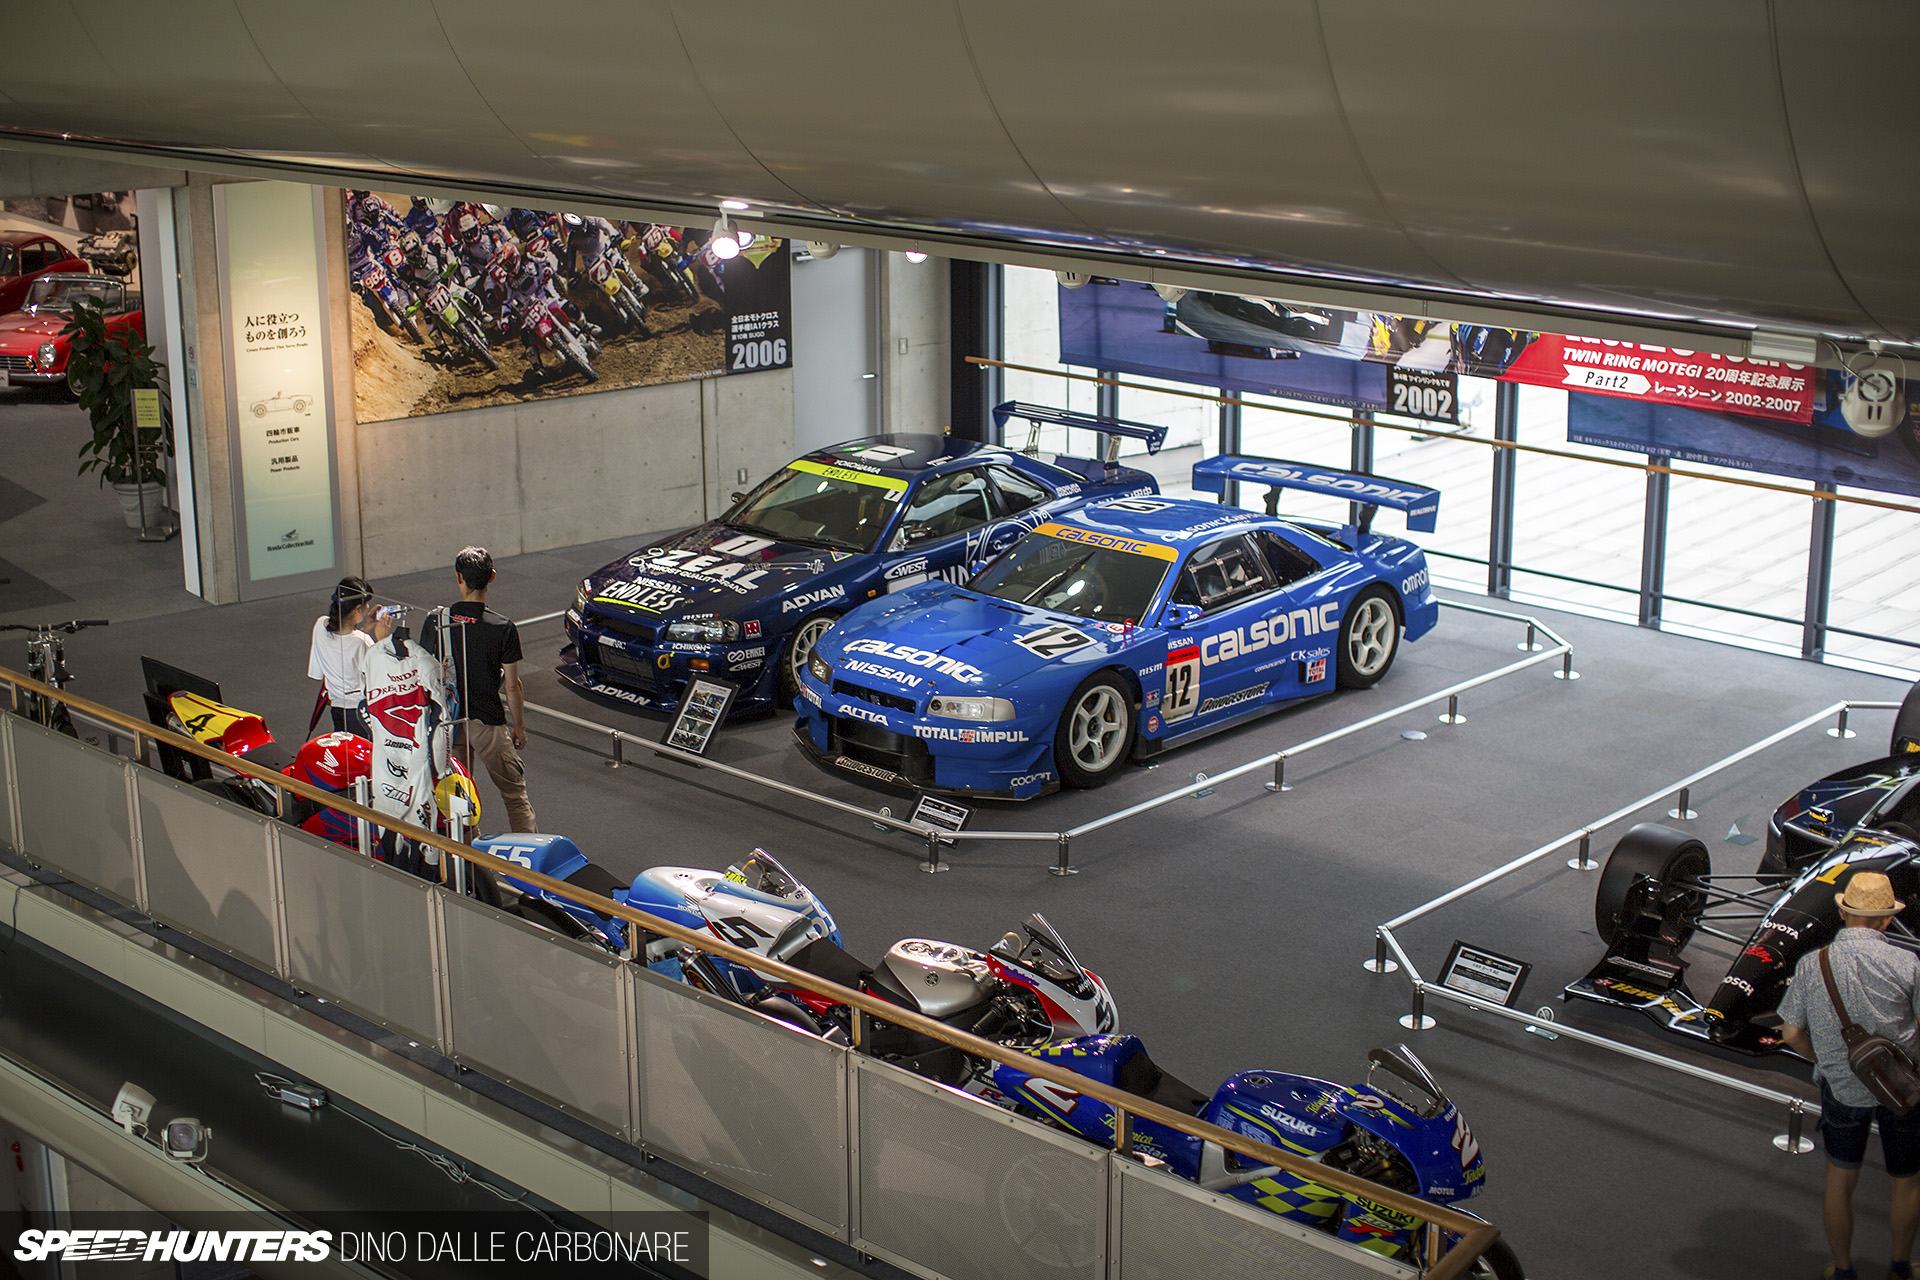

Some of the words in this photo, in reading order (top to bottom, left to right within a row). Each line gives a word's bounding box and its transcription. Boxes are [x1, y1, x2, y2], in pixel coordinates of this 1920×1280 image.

[245, 313, 300, 328] 人に役立つ
[731, 311, 779, 324] 全日本モトクロス
[246, 326, 306, 343] ものを創ろう
[732, 338, 787, 369] 2006
[1563, 347, 1602, 365] TWIN
[1602, 352, 1641, 370] RING
[1642, 358, 1703, 378] MOTEGI
[1585, 371, 1629, 389] Part2
[1393, 382, 1453, 419] 2002
[1654, 380, 1722, 402] レースシーン
[1726, 391, 1801, 413] 2002-2007
[822, 467, 860, 480] ENDLESS
[834, 459, 881, 475] YOKOHAMA
[652, 549, 768, 591] ZEAL
[600, 580, 686, 611] ENDLESS
[633, 576, 681, 595] NISSAN
[782, 584, 845, 613] ADVAN
[672, 643, 707, 652] ICHIKOH
[745, 646, 766, 659] ENKEI
[1020, 626, 1091, 657] 12
[1290, 650, 1306, 661] CK
[1306, 646, 1331, 659] sales
[844, 659, 923, 688] NISSAN
[1308, 667, 1326, 677] TOTAL
[591, 684, 651, 706] ADVAN
[1169, 664, 1192, 711] 12
[1197, 681, 1270, 711] BRIDGESTONE
[806, 688, 822, 710] TOTAL
[184, 713, 217, 735] 4
[913, 725, 958, 741] TOTAL
[975, 730, 1030, 743] IMPUL
[315, 760, 336, 775] HONDA
[835, 756, 897, 782] BRIDGESTONE
[1260, 1103, 1318, 1138] SUZUKI
[1428, 1187, 1455, 1197] MOTUL
[1355, 1196, 1415, 1224] SUZUKI
